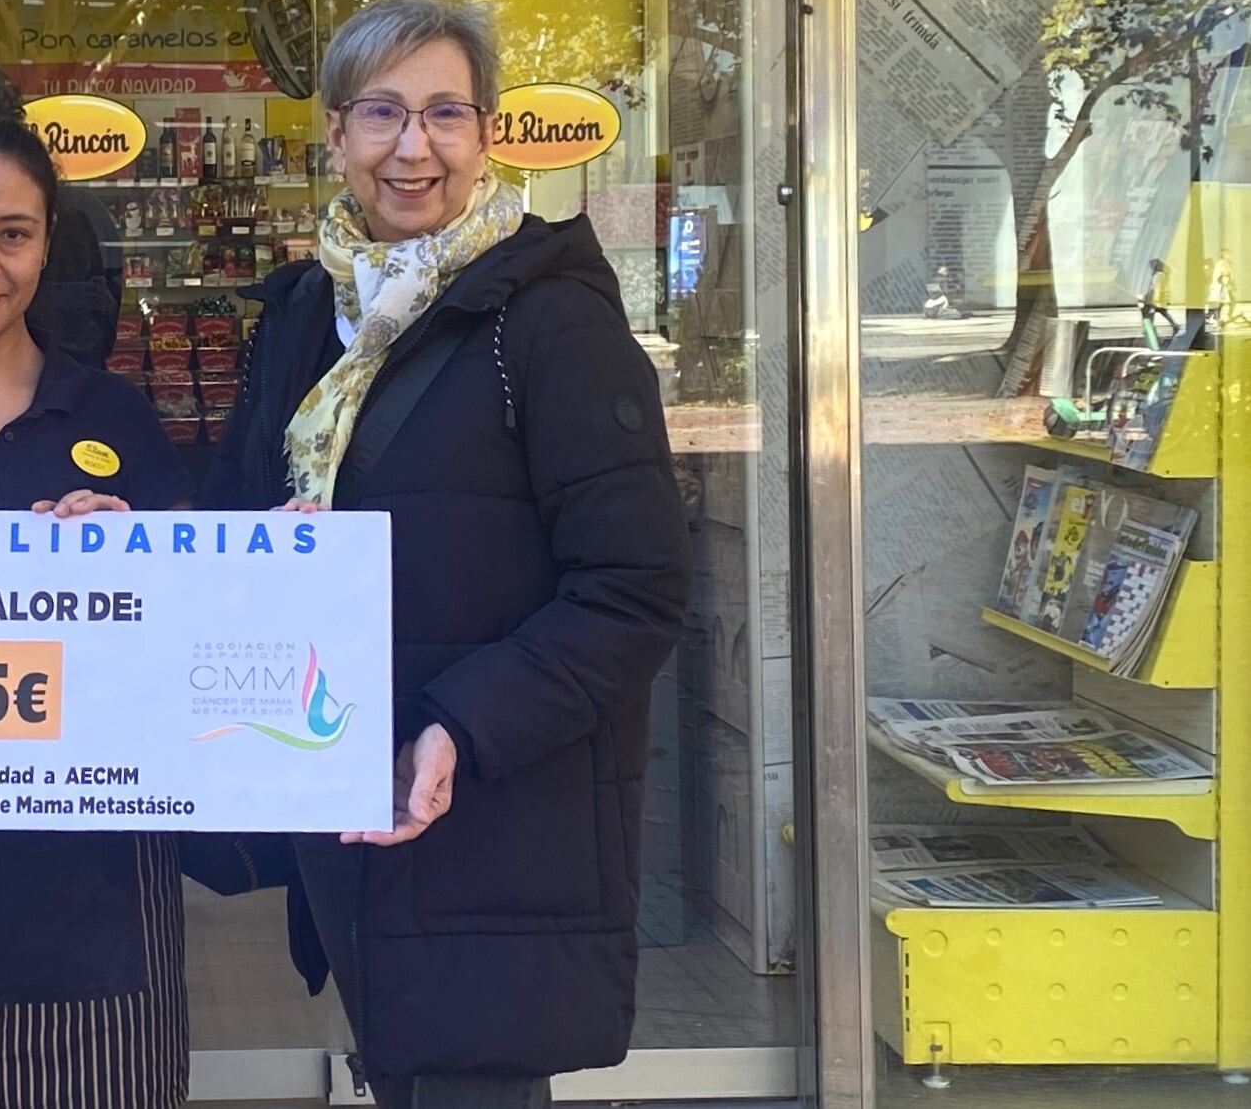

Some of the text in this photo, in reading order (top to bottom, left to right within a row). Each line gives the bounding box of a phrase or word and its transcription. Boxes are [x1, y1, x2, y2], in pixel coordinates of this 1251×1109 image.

[20, 28, 77, 50] Pon
[86, 29, 218, 50] caramelos
[121, 77, 197, 94] NAVIDAD
[44, 121, 130, 154] Rincón
[517, 111, 604, 144] Rincón
[87, 593, 144, 623] DE:
[193, 640, 295, 650] ASOCIACIÓN
[189, 665, 295, 690] CMM
[241, 697, 256, 705] DE
[43, 772, 55, 785] a
[65, 766, 139, 785] AECMM
[16, 796, 75, 815] Mama
[79, 797, 195, 817] Metastásico
